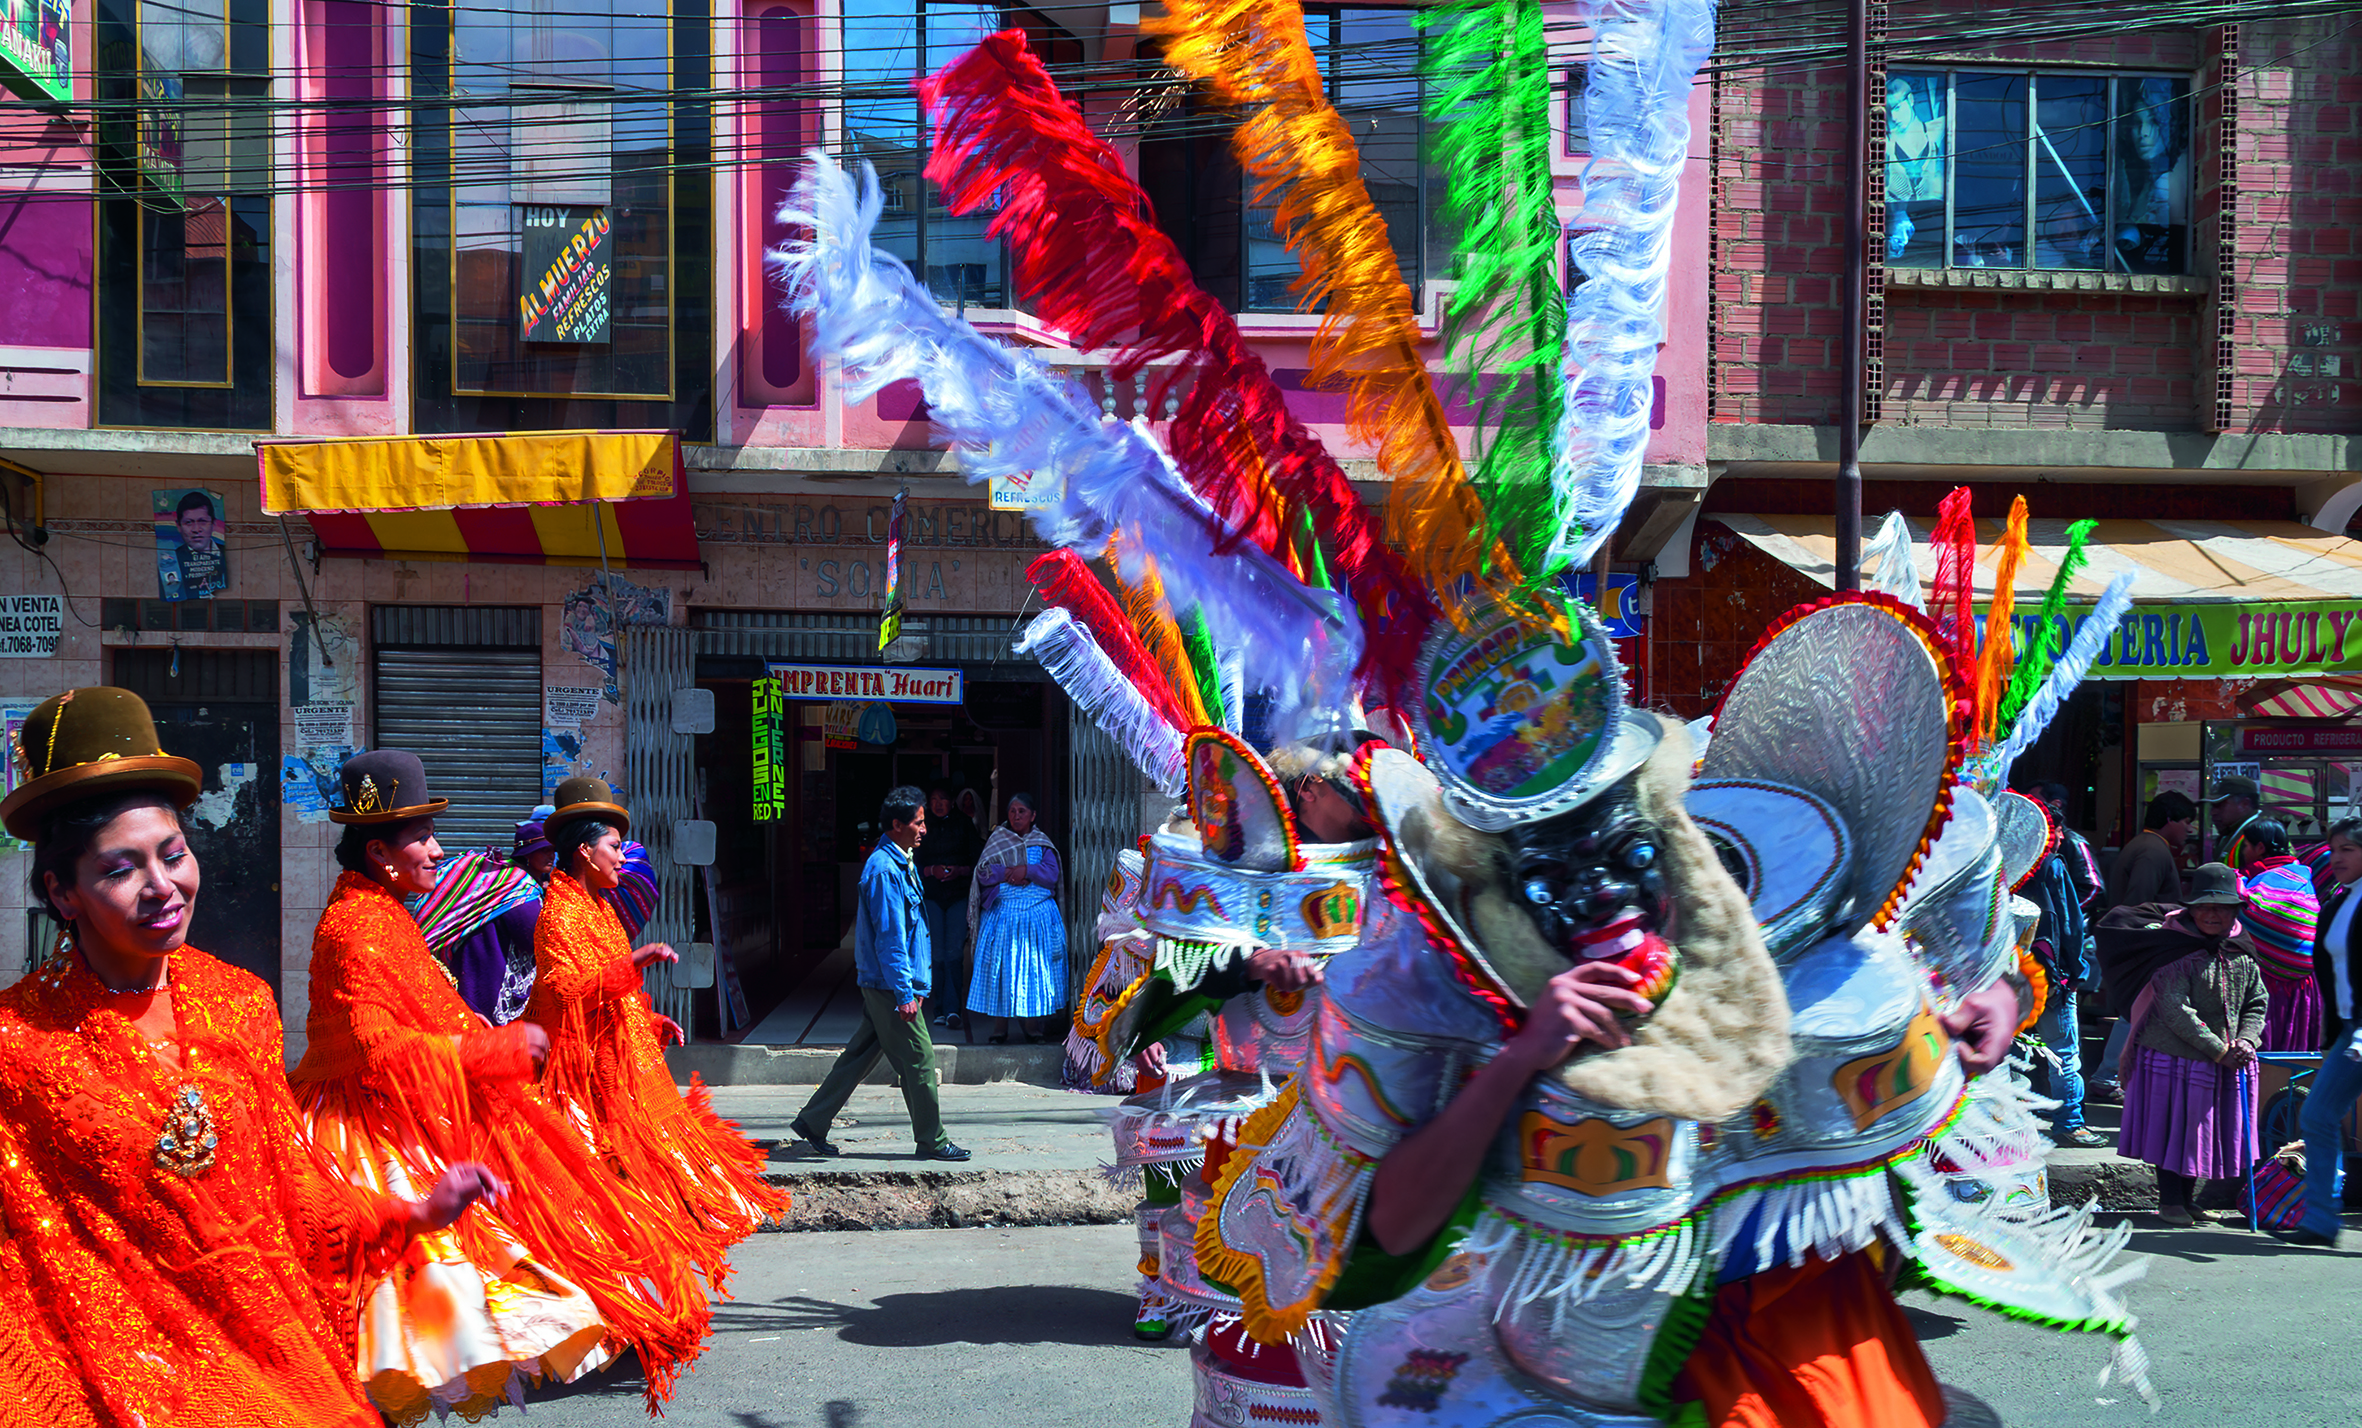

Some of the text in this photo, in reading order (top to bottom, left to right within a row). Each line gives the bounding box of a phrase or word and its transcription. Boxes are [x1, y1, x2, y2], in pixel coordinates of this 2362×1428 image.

[526, 207, 571, 229] HOY
[520, 209, 610, 338] ALMUERZO
[552, 261, 596, 322] FAMILIAR
[556, 263, 611, 341] REFRESCOS
[573, 291, 607, 341] PLATOS
[584, 308, 610, 342] EXTRA
[691, 503, 1042, 546] CENTRO CMERCI
[11, 597, 60, 613] VENTA
[24, 616, 61, 632] COTEL
[1974, 613, 2211, 667] POERIA
[1433, 620, 1552, 710] PRINCIPA
[547, 686, 600, 695] URGENTE
[774, 669, 886, 697] IMPRENTA
[295, 706, 349, 714] URGENTE
[752, 677, 769, 785] JUEGOS
[2254, 733, 2362, 746] PRODUCTO REFRIGERA
[769, 677, 785, 820] INTERNET
[753, 784, 770, 802] EN
[753, 802, 771, 820] RED
